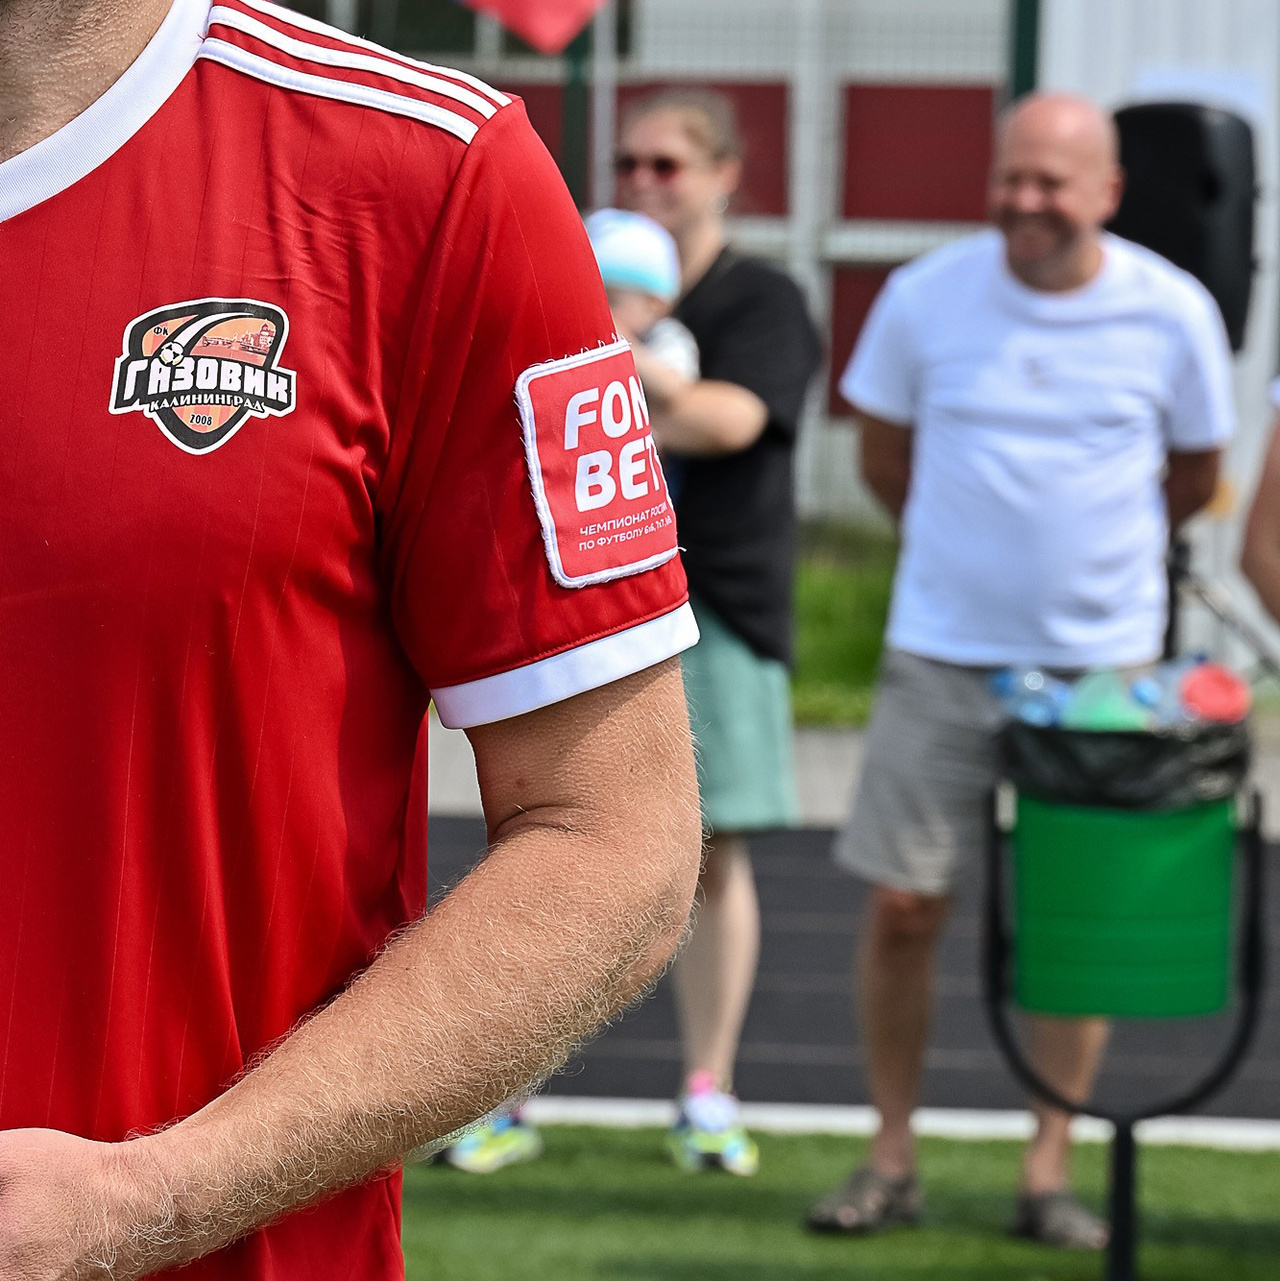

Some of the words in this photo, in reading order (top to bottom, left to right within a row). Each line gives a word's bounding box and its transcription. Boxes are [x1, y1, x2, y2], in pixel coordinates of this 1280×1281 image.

[154, 326, 169, 335] ФК
[123, 357, 289, 404] ГАЗОВИК
[149, 393, 265, 413] КАЛИНИНГРАД
[564, 375, 650, 450] FON
[575, 433, 660, 512] BET
[580, 509, 650, 536] ЧЕМПИОНАТ
[579, 540, 595, 551] ПО
[597, 527, 644, 546] ФУТБОЛУ
